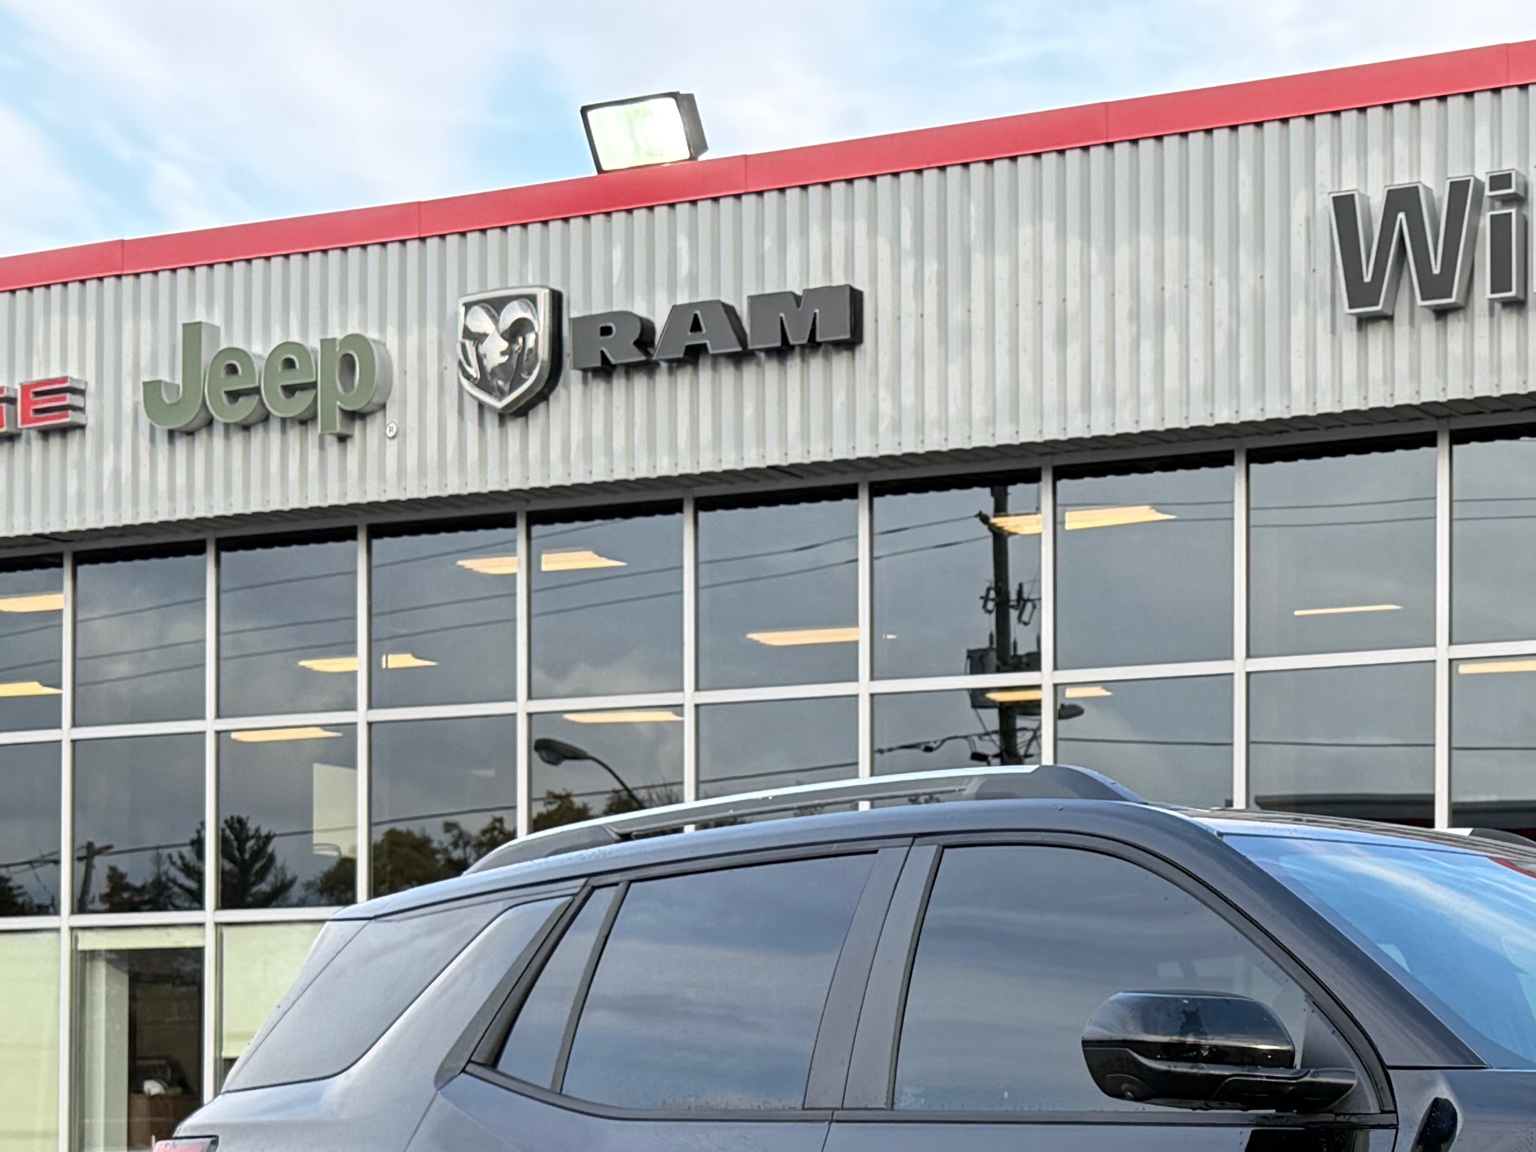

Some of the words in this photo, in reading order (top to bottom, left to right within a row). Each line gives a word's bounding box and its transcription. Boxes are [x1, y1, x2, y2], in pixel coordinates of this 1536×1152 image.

[570, 283, 864, 372] RAM
[0, 375, 87, 434] E
[142, 320, 392, 437] Jeep
